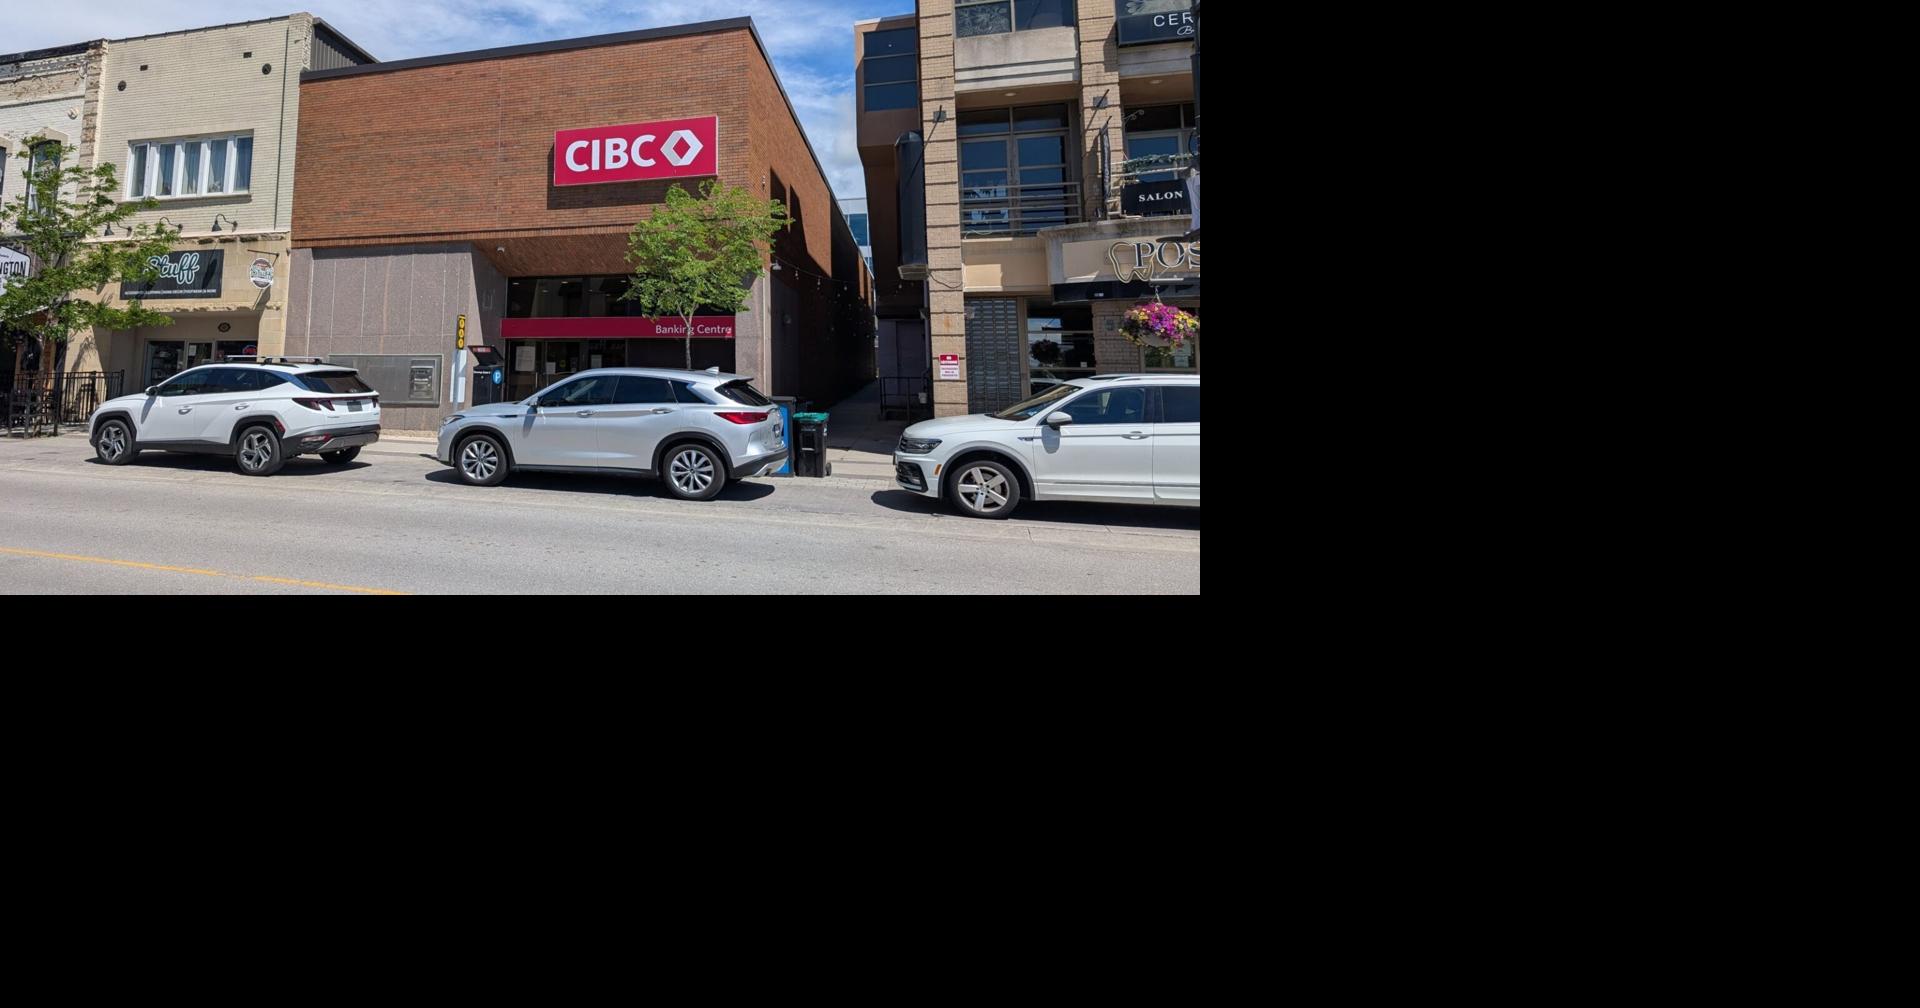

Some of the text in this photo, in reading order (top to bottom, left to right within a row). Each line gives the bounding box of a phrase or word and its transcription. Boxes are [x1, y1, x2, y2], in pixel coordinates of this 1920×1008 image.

[565, 134, 656, 172] CIBC
[1138, 191, 1184, 202] SALON
[143, 252, 200, 285] Stuff
[655, 324, 733, 336] Banking Centre
